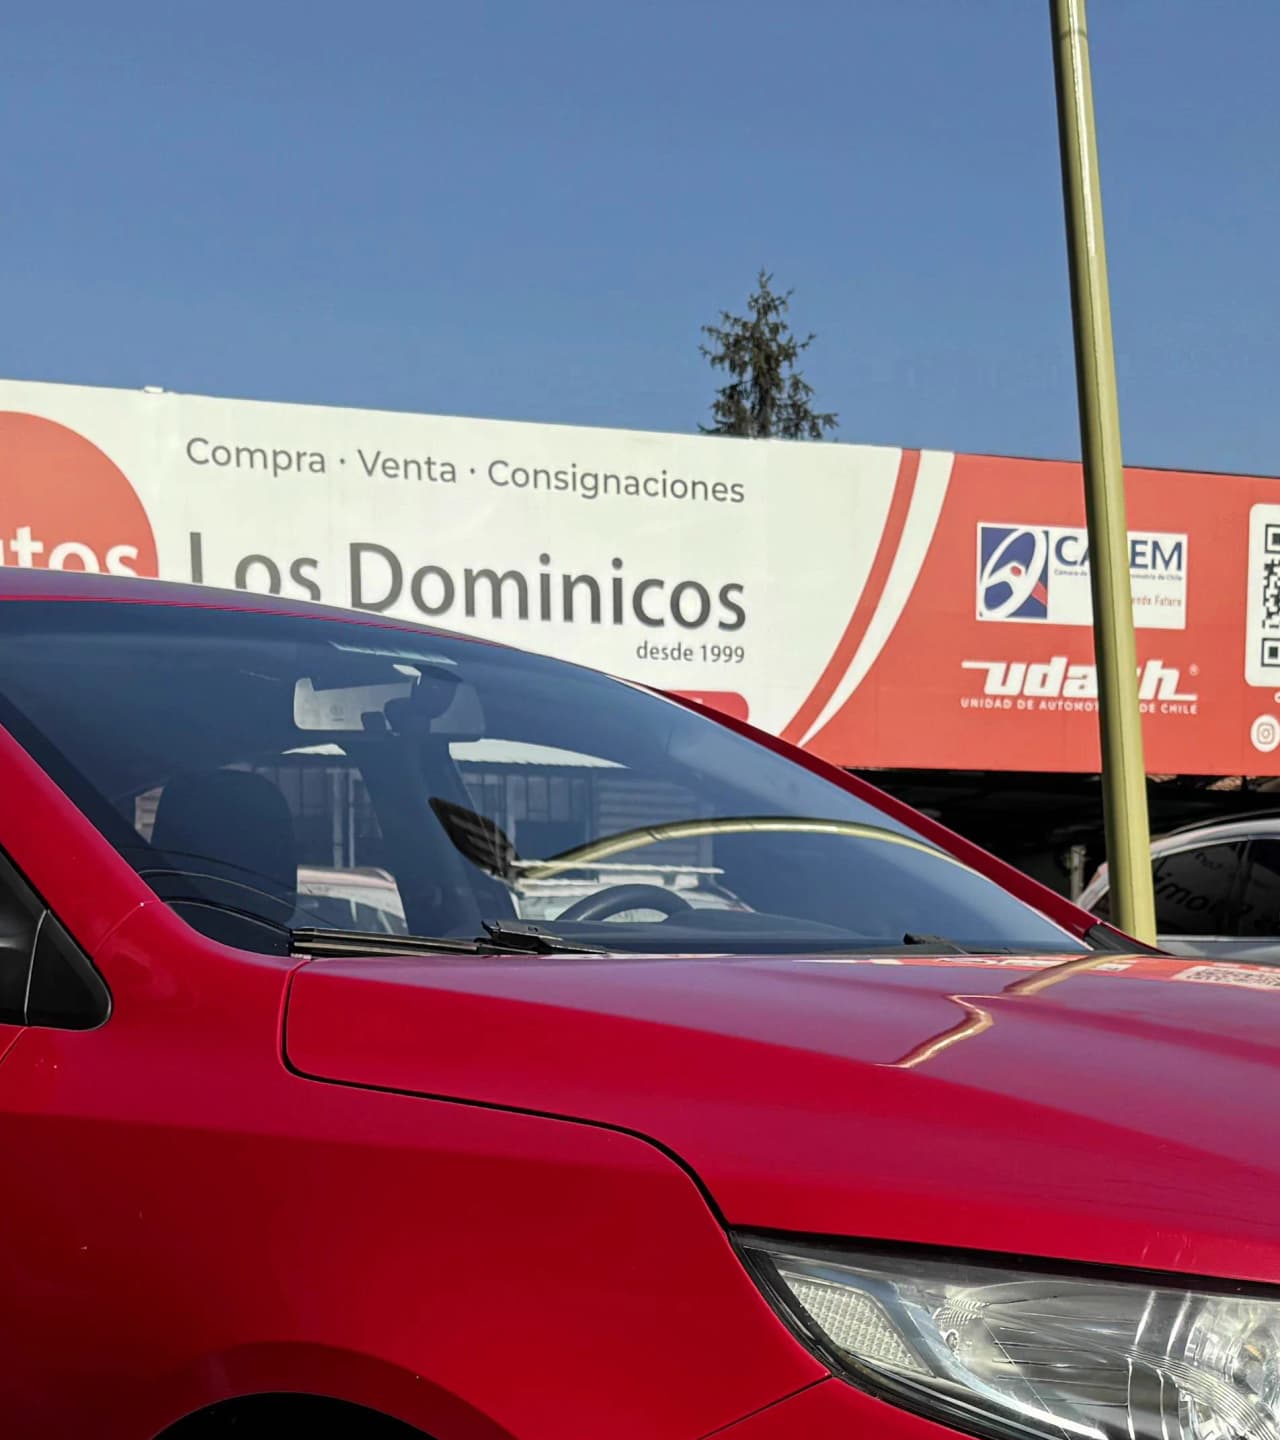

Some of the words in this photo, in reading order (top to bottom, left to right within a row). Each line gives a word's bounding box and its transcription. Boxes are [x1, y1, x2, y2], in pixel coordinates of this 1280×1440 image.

[186, 437, 326, 478] Compra
[357, 449, 457, 483] Venta
[487, 459, 746, 503] Consignaciones
[348, 541, 748, 632] Dominicos
[636, 639, 694, 662] desde
[700, 644, 745, 663] 1999
[961, 656, 1199, 702] udah
[960, 697, 1012, 710] UNIDAD
[1017, 698, 1034, 711] DE
[1139, 702, 1156, 714] DE
[1161, 703, 1198, 715] CHILE
